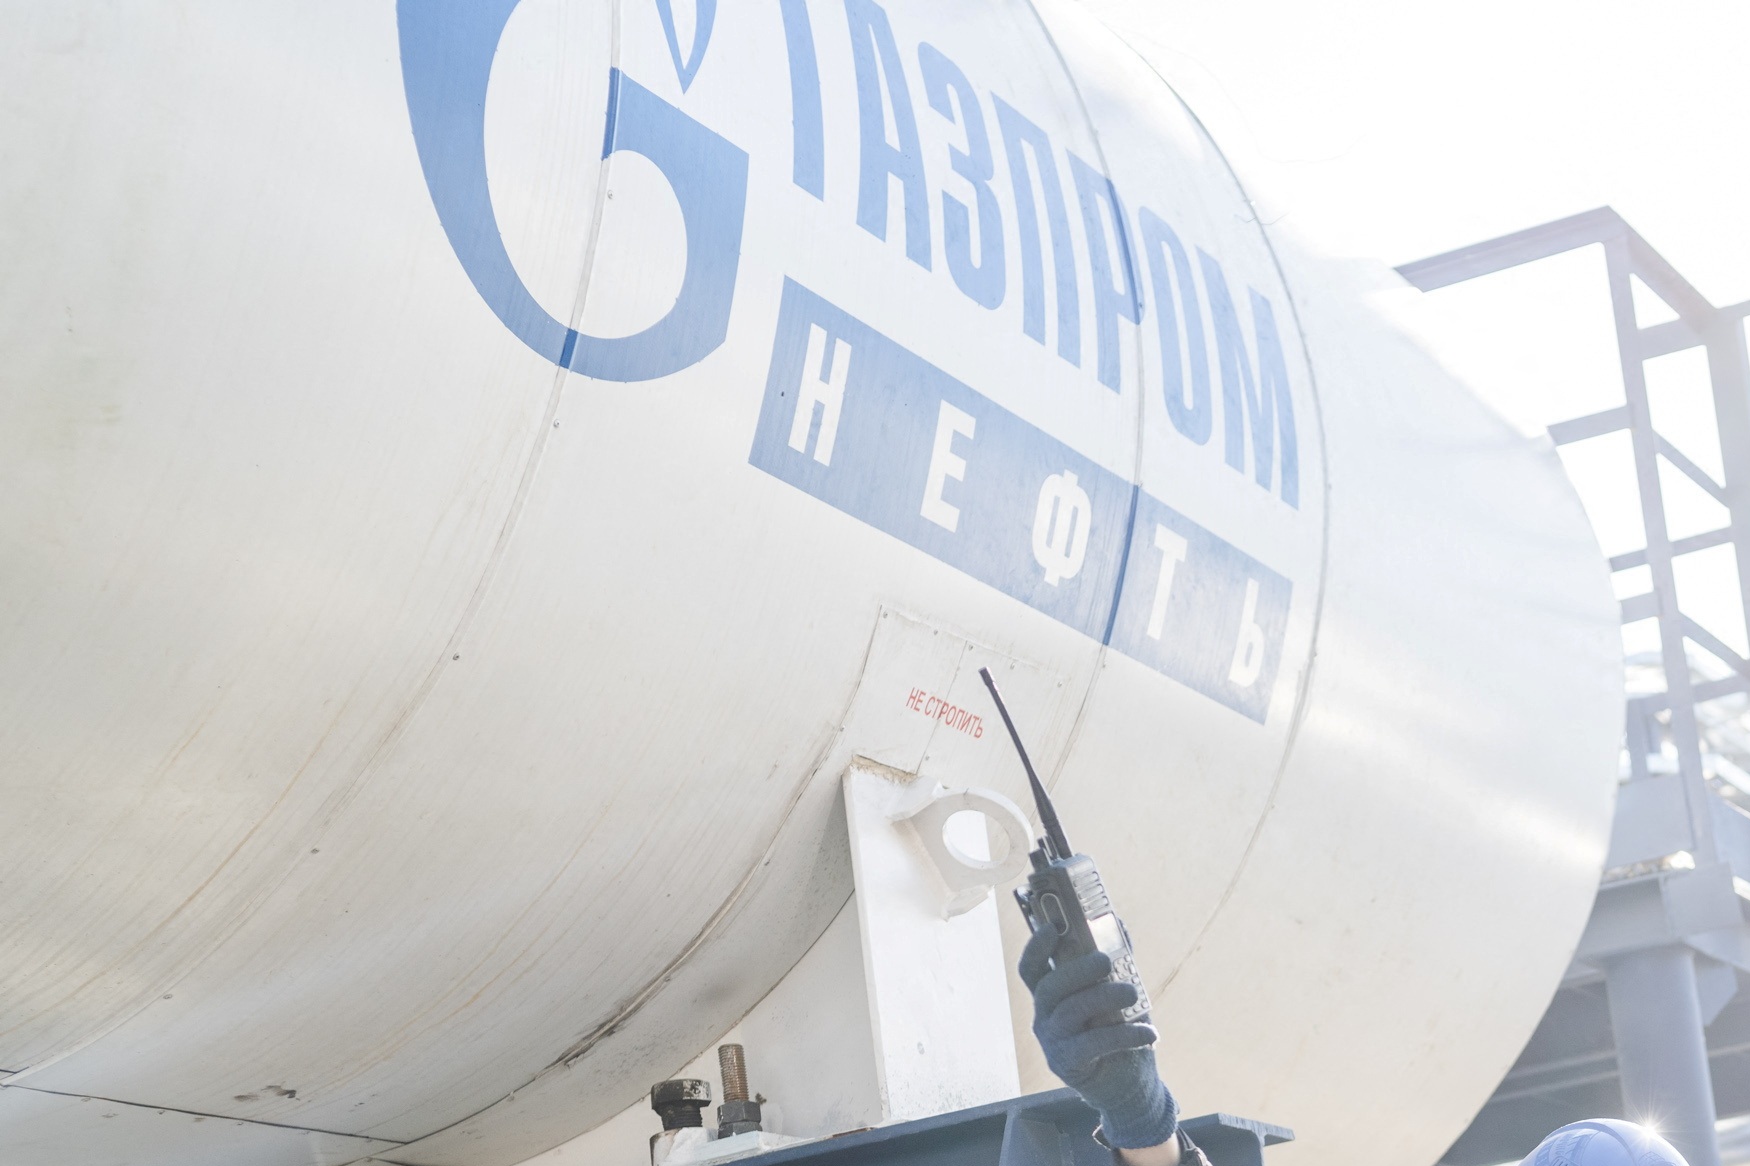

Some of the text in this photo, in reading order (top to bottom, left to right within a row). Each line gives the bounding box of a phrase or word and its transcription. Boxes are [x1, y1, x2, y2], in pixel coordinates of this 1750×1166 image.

[788, 323, 1266, 688] НЕФТЬ
[905, 687, 984, 739] НЕ СТРОПИТЬ
